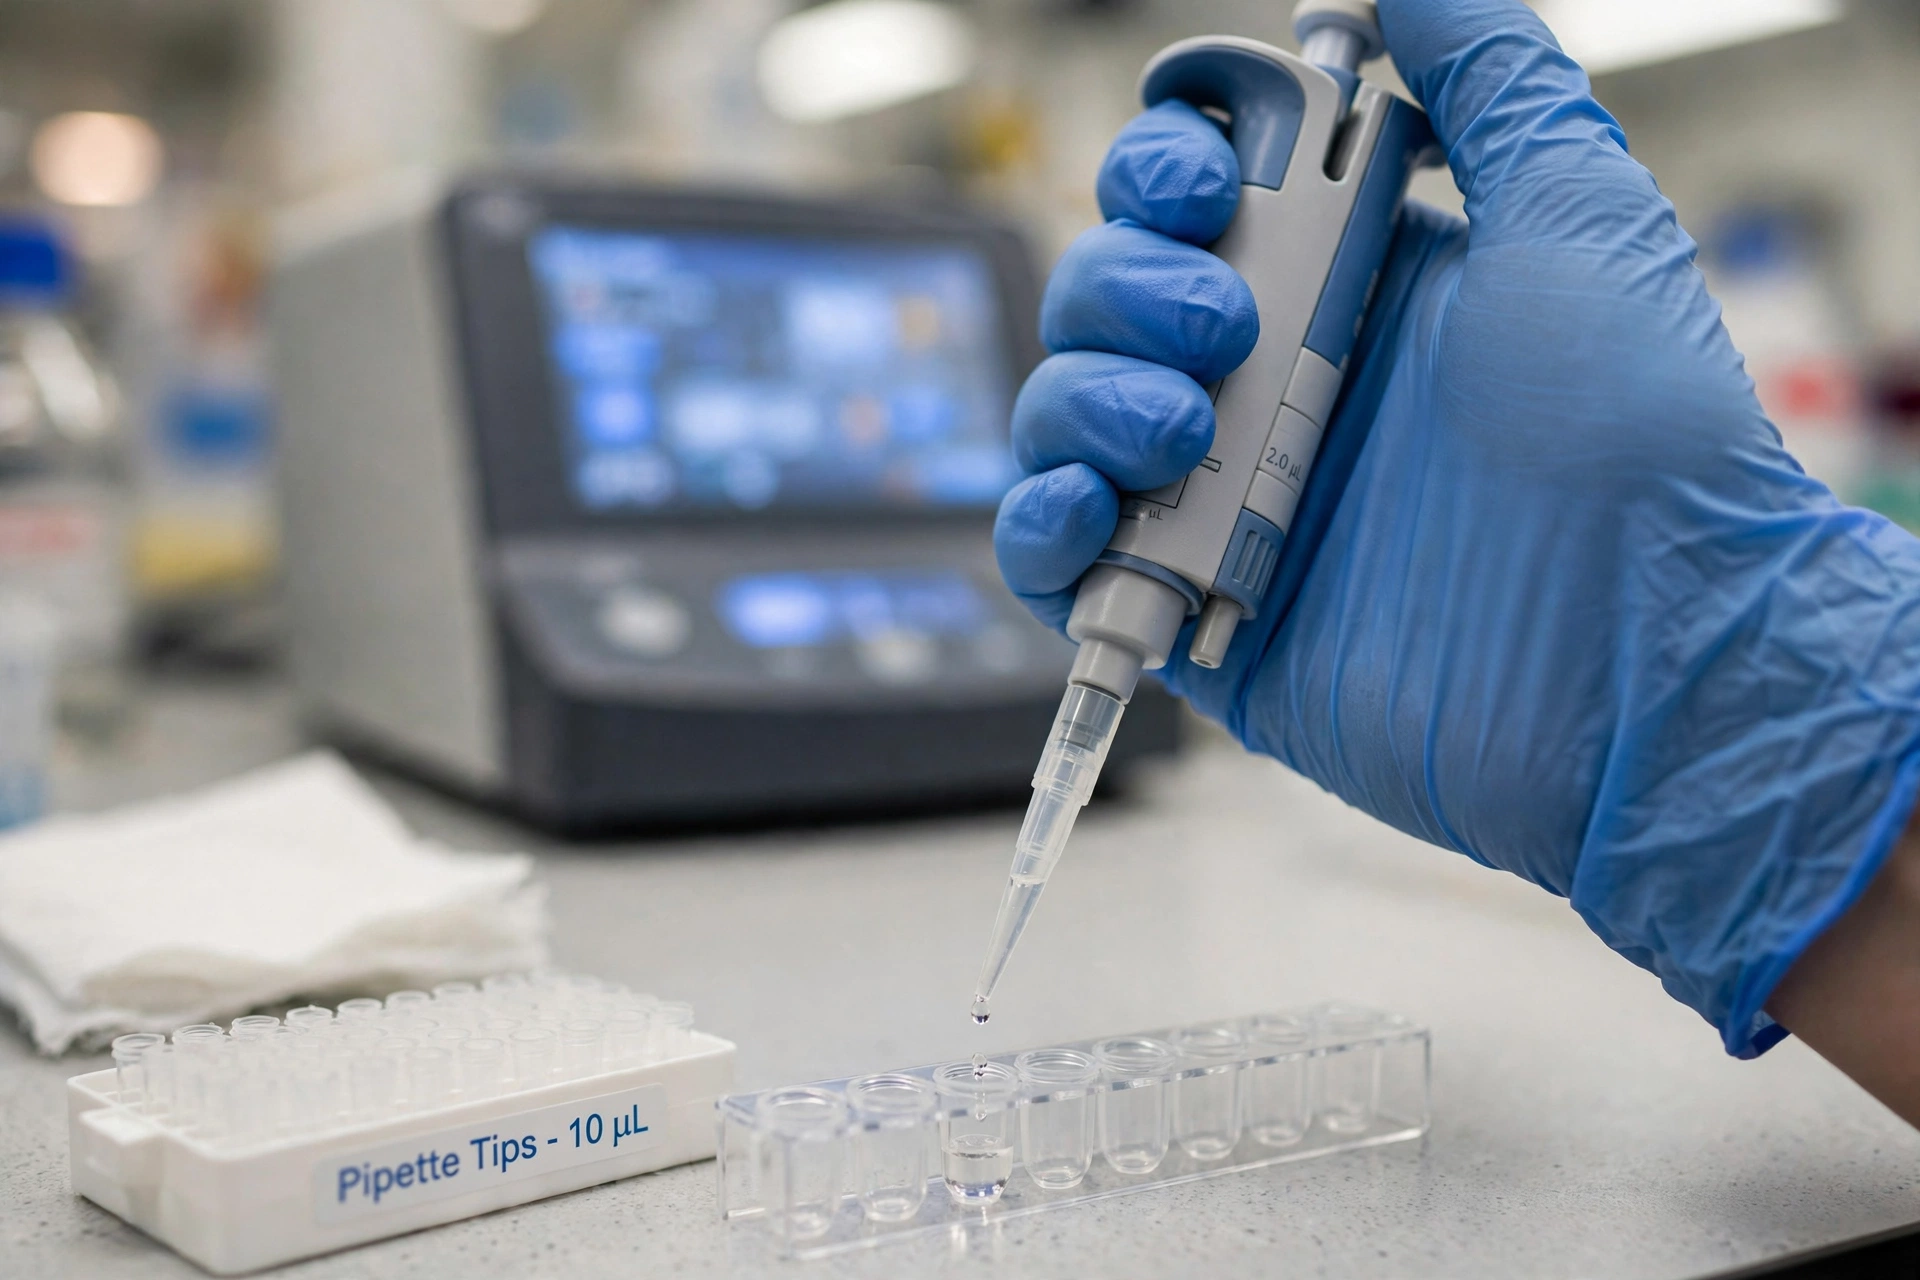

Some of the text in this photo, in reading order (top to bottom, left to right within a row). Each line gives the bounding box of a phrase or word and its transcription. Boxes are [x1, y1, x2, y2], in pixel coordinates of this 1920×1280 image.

[1265, 446, 1289, 470] 2.0
[337, 1104, 649, 1204] Pipette Tips - 10 µL
